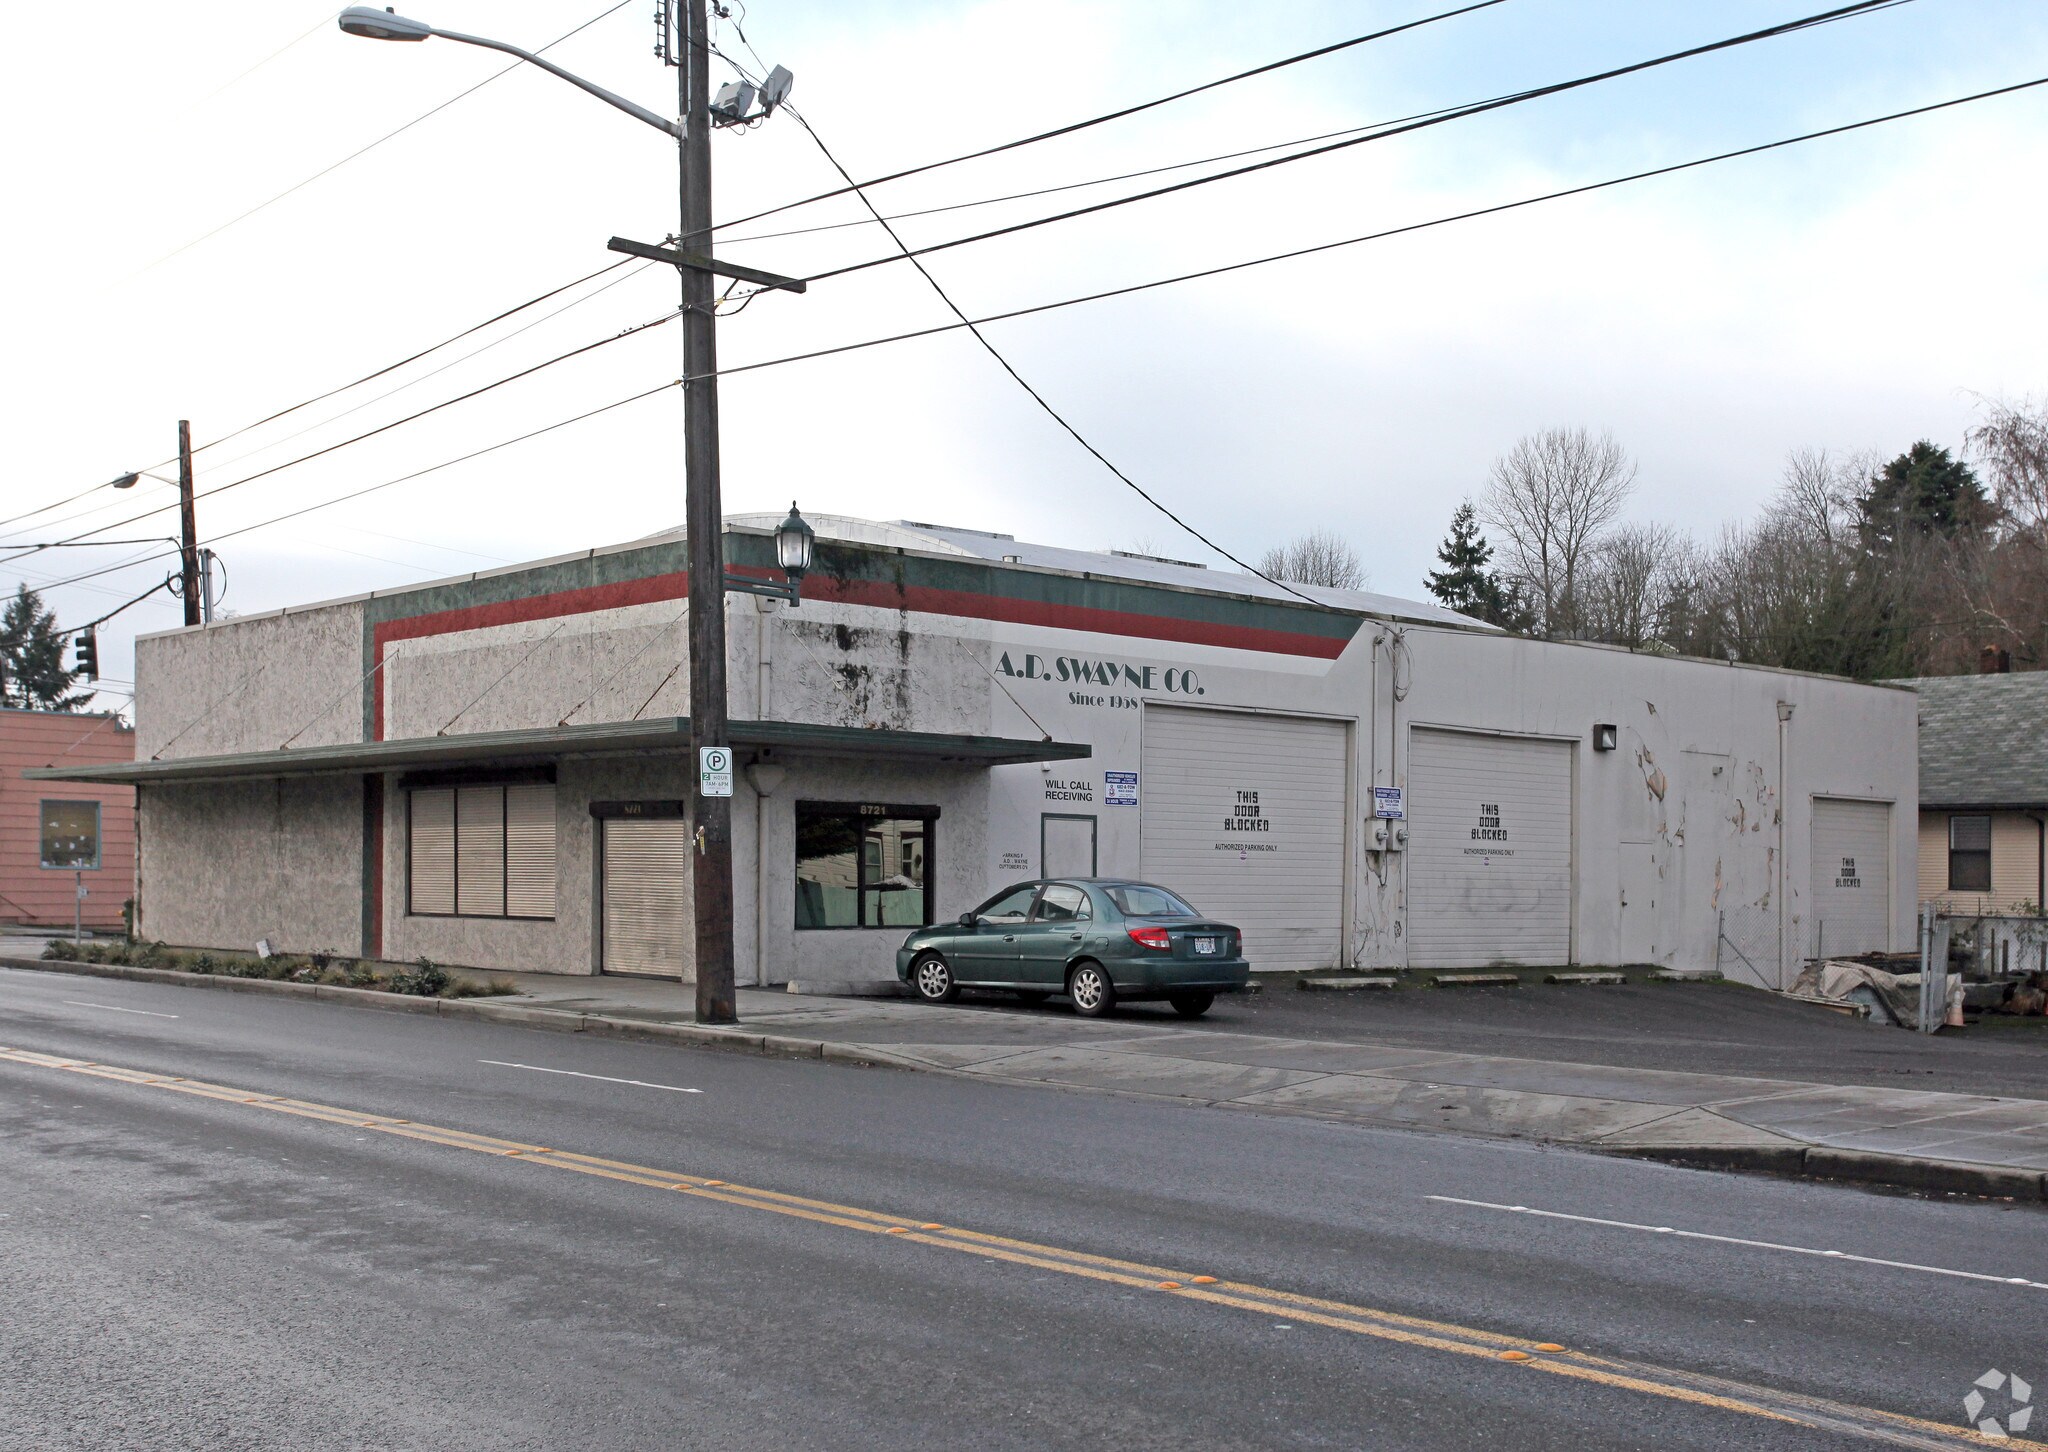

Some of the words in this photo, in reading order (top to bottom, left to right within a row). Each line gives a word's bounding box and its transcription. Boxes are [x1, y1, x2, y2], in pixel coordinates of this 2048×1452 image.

[993, 650, 1051, 681] A.D.
[1055, 656, 1158, 691] SWAYNE
[1164, 667, 1205, 695] CO.
[1068, 691, 1105, 707] Since
[1109, 695, 1138, 710] 1958
[1045, 779, 1067, 789] WILL
[1069, 780, 1093, 791] CALL
[1045, 791, 1093, 802] RECEIVING
[1237, 791, 1258, 804] THIS
[860, 805, 886, 815] 8721
[1234, 805, 1260, 817] DOOR
[1481, 804, 1499, 815] THIS
[1224, 818, 1269, 831] BLOCKED
[1479, 817, 1500, 828] DOOR
[1471, 828, 1507, 841] BLOCKED
[1215, 843, 1244, 851] AUTHORIZED
[1842, 857, 1855, 867] THIS
[1841, 868, 1856, 877] DOOR
[1835, 878, 1861, 888] BLOCKED
